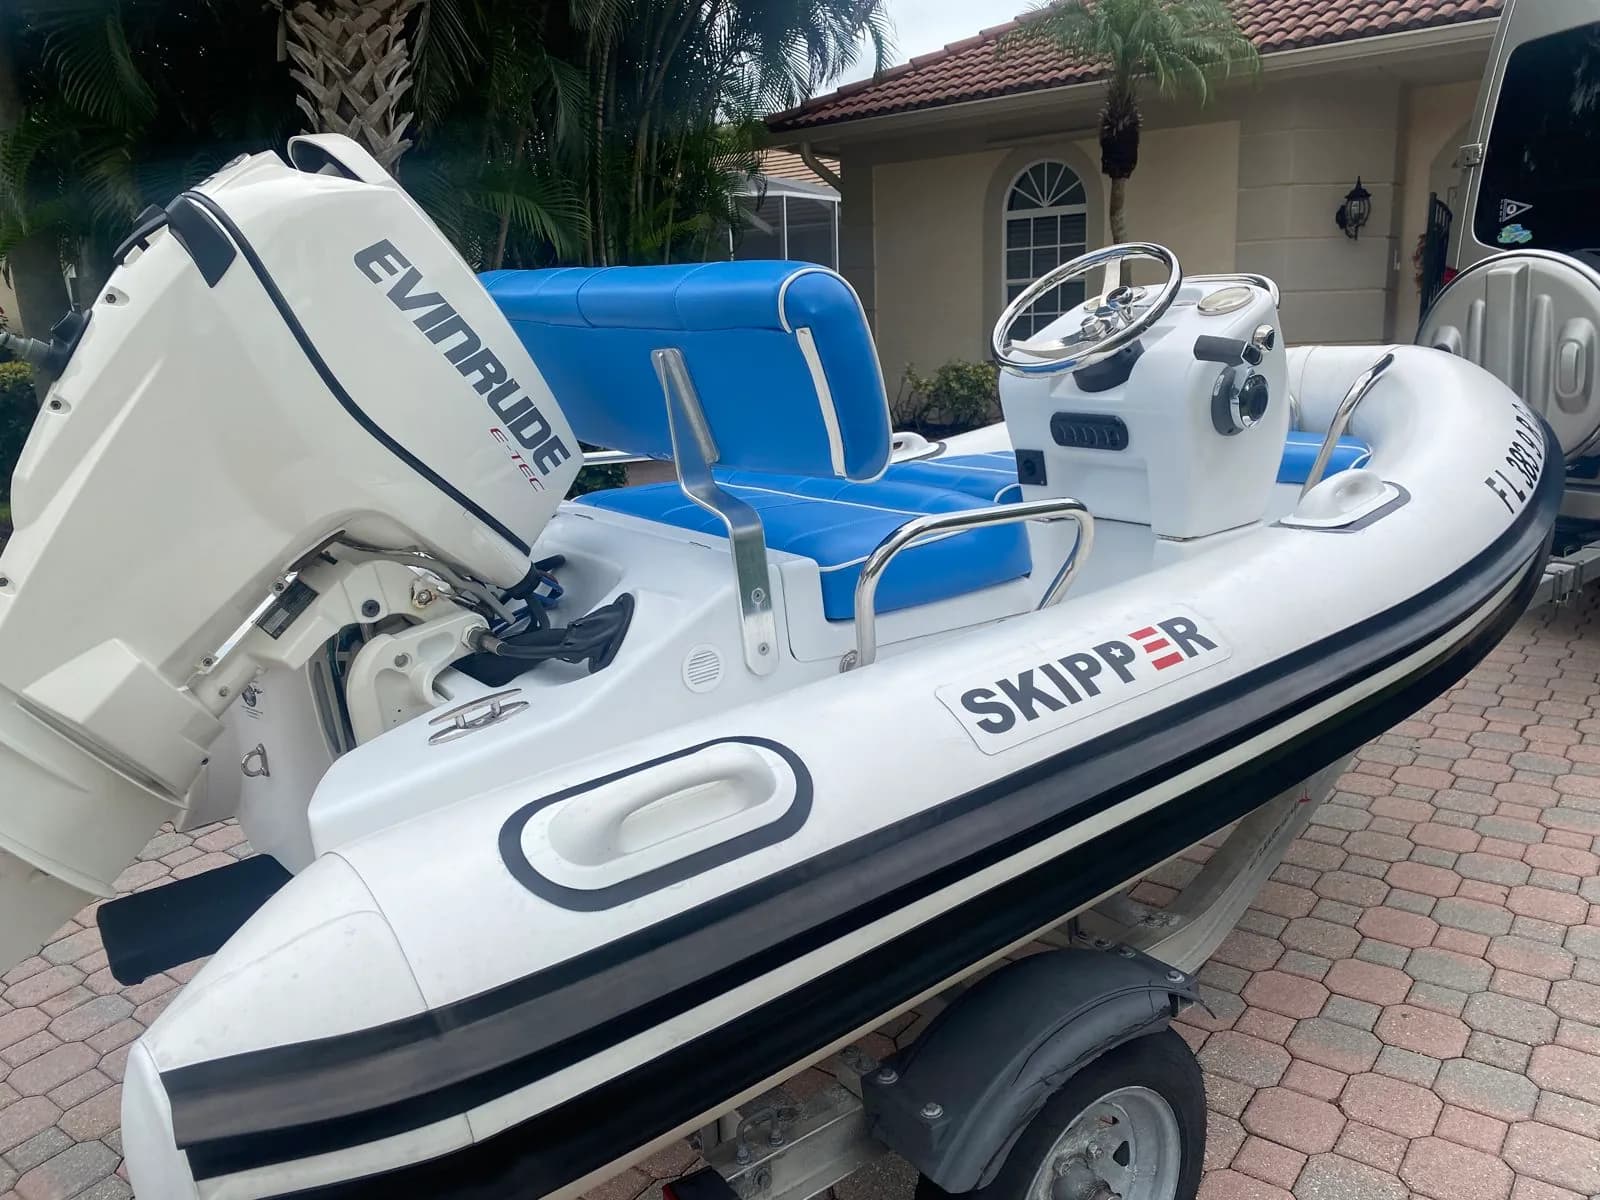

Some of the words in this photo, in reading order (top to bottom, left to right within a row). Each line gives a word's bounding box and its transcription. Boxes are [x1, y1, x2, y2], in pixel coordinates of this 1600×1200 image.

[354, 239, 571, 476] EVINRUDE
[489, 428, 545, 493] E-TEC
[960, 616, 1219, 734] SKIPPER
